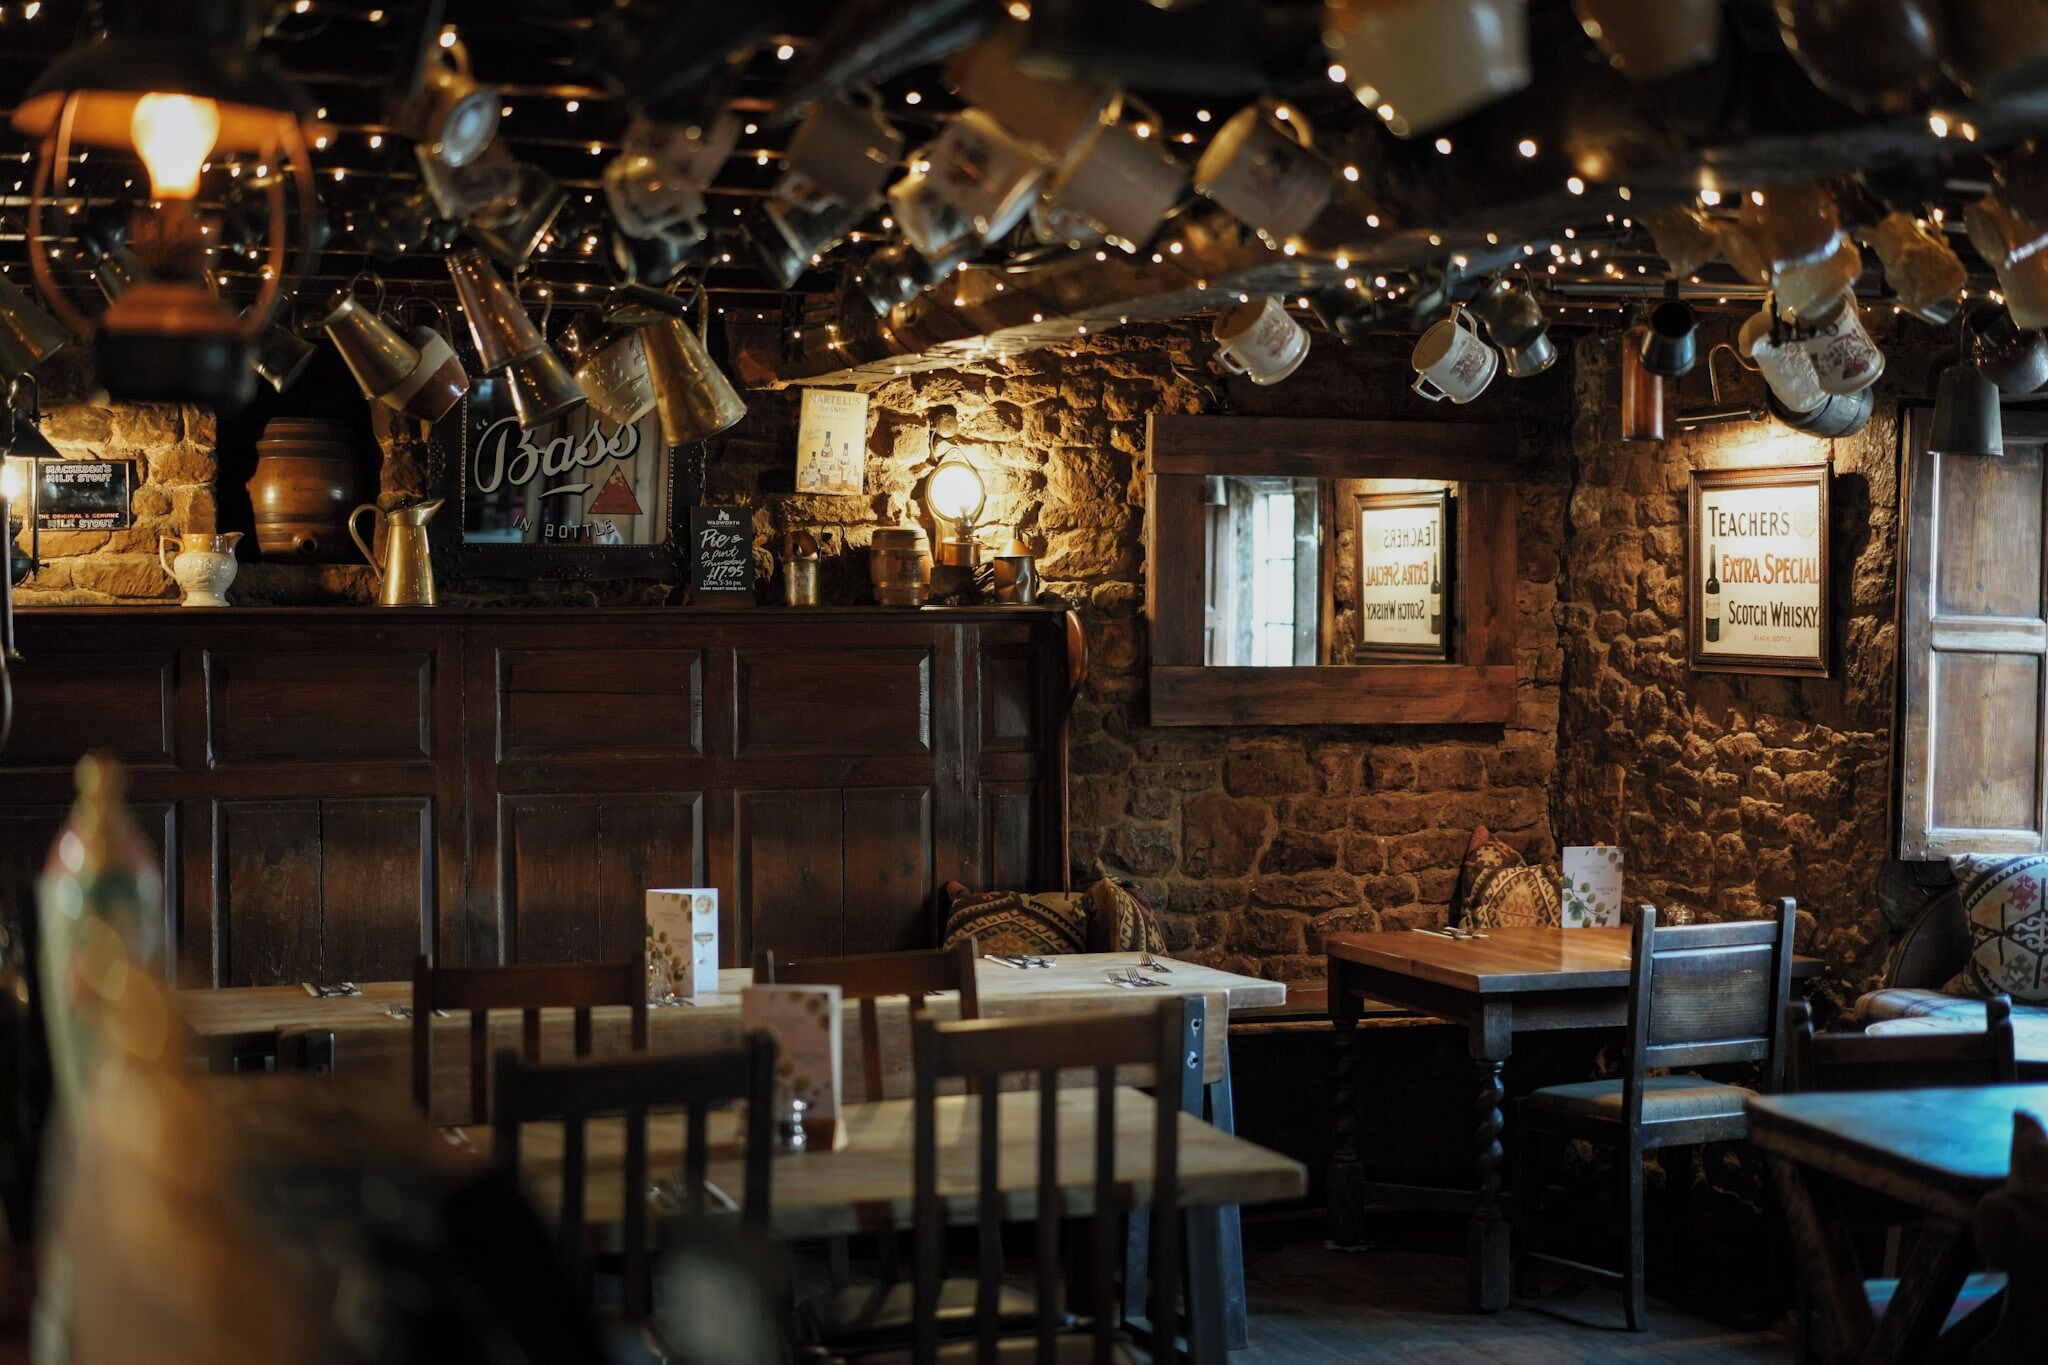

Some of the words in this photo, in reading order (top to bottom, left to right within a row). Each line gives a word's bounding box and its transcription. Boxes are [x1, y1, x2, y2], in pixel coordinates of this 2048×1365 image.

[45, 474, 74, 483] MILK
[77, 474, 112, 483] STOUT
[47, 519, 76, 529] MILK
[78, 519, 114, 529] STOUT
[512, 514, 533, 535] IN
[544, 519, 617, 540] BOTTLE
[712, 545, 739, 561] pint
[1722, 554, 1761, 584] EXTRA
[1762, 553, 1819, 585] SPECIAL
[1728, 600, 1767, 627] SCOTCH
